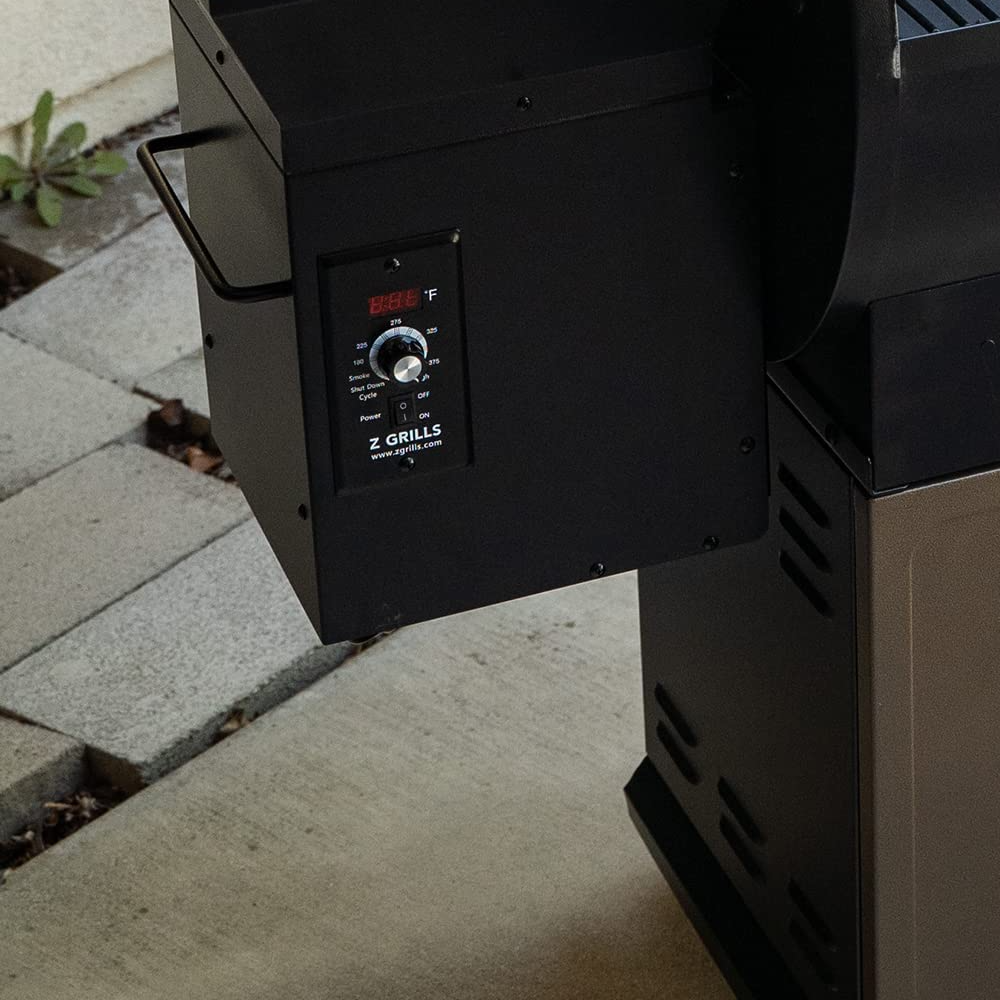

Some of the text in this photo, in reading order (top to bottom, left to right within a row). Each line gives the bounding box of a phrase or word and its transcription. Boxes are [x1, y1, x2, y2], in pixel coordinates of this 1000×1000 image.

[390, 318, 402, 326] 275
[356, 342, 368, 350] 225
[428, 358, 440, 366] 375
[349, 373, 370, 381] Smoke
[350, 381, 386, 394] Shut Down
[359, 392, 378, 401] Cycle
[417, 390, 430, 399] OFF
[360, 413, 381, 422] Power
[418, 412, 430, 420] ON
[369, 424, 442, 451] Z GRILLS
[370, 439, 442, 460] www.zgrills.com
